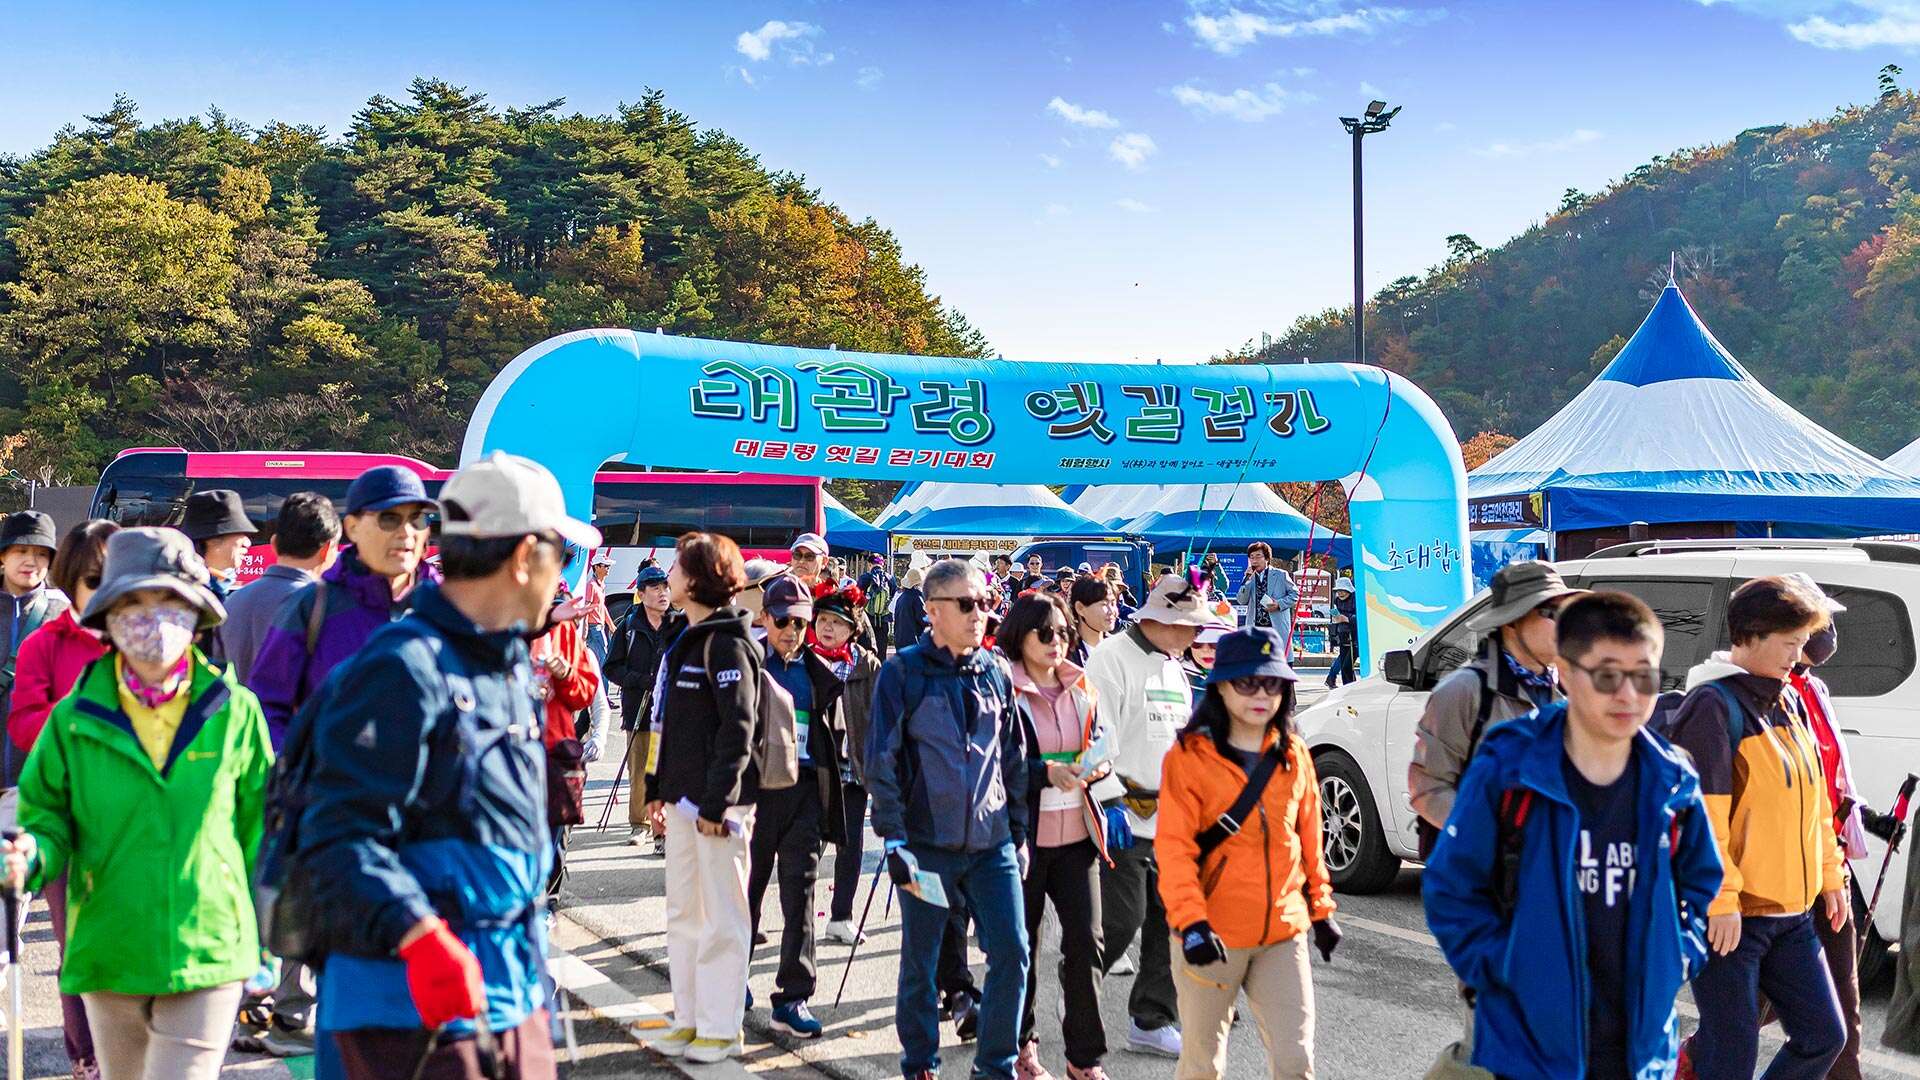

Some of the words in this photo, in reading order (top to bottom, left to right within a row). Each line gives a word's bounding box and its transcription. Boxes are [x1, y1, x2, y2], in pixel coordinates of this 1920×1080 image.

[690, 360, 994, 445] 대관령
[733, 439, 818, 462] 대굴령
[824, 445, 880, 465] 옛길
[888, 449, 996, 469] 걷기대회
